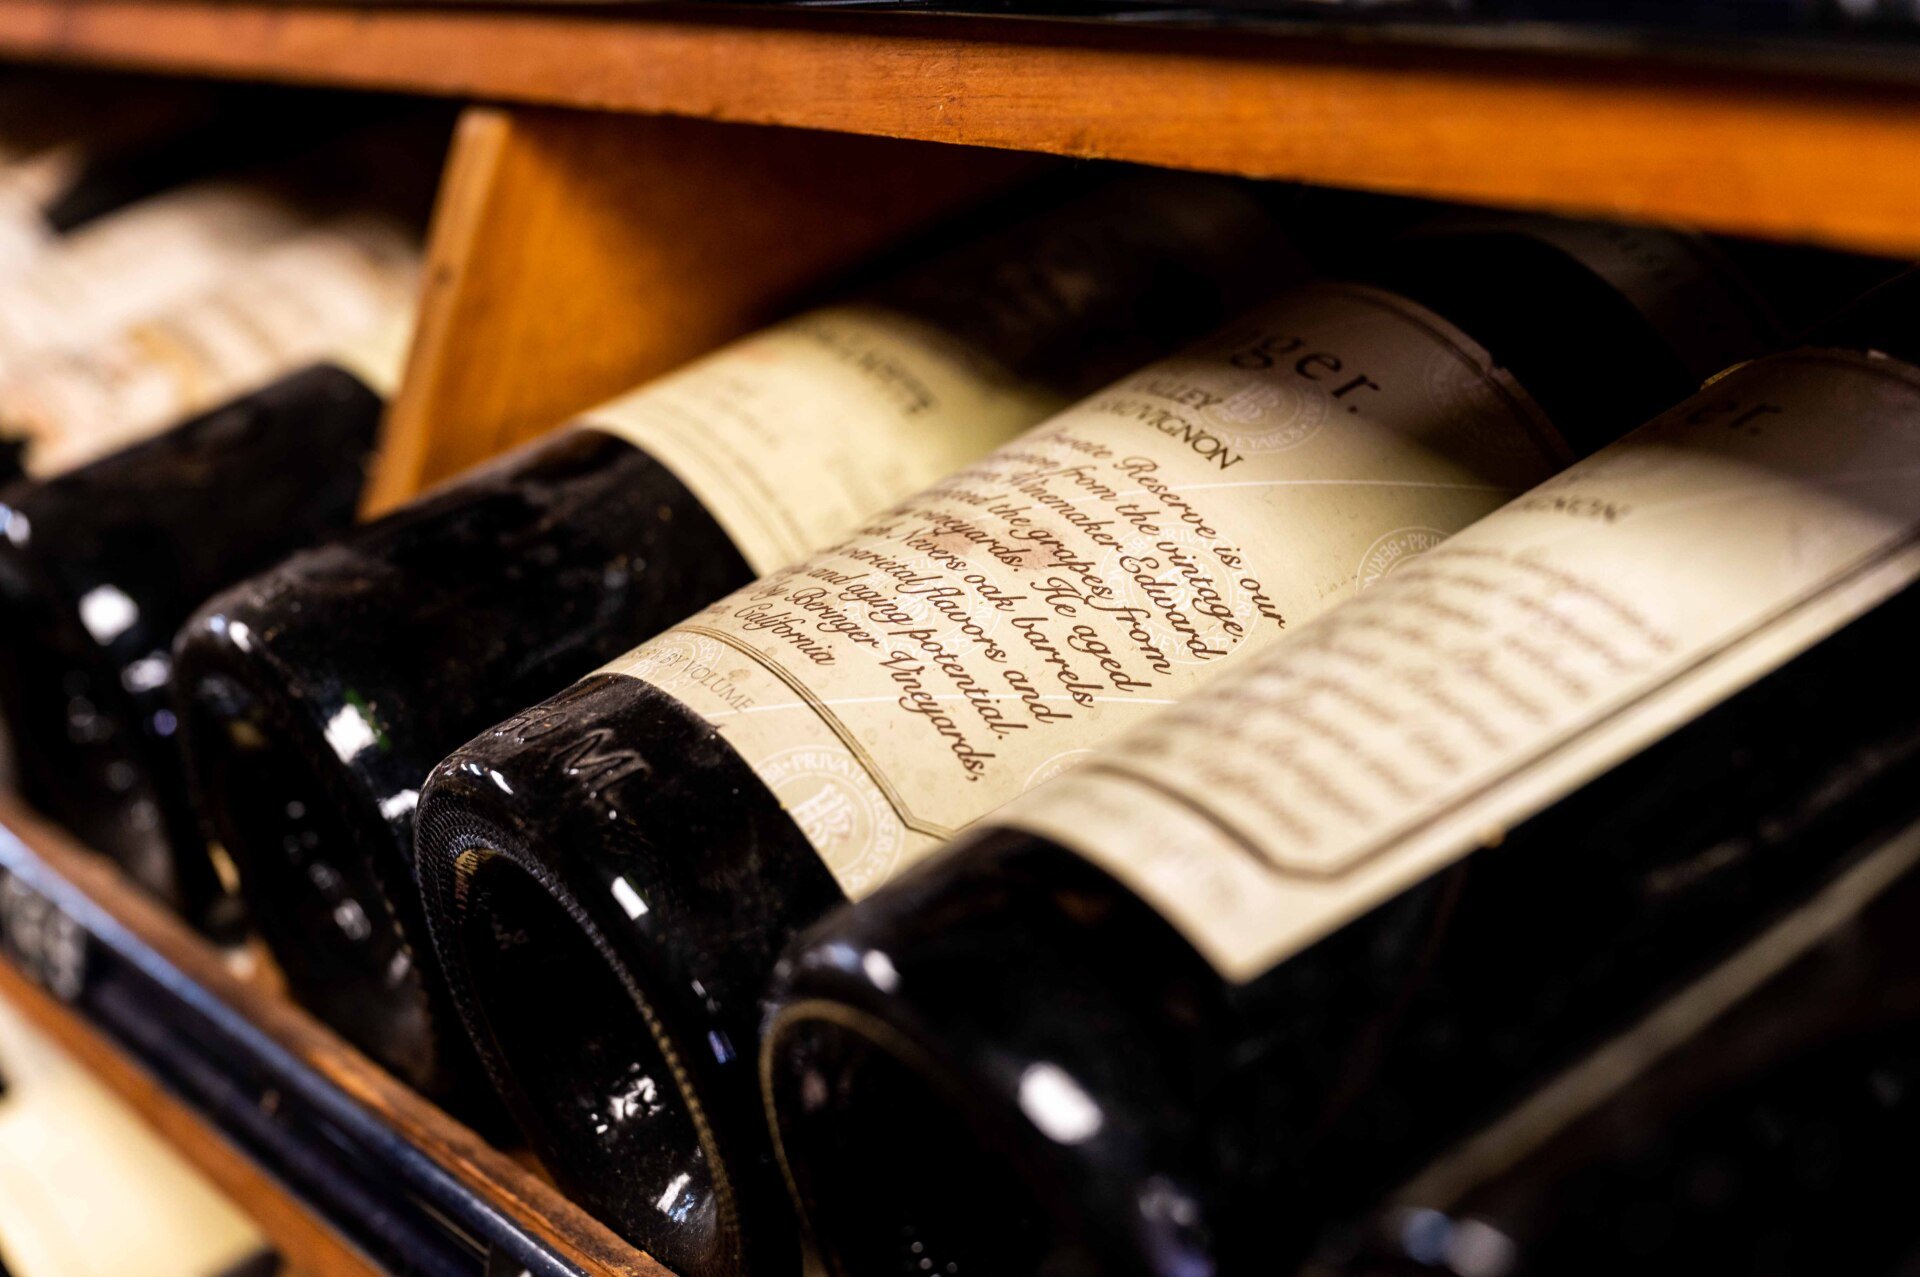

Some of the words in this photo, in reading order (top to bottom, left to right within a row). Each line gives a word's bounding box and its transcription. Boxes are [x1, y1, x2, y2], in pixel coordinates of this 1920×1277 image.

[987, 502, 1032, 528] the
[1006, 469, 1124, 554] Winemaker
[1118, 555, 1229, 660] Edward
[1008, 528, 1114, 600] grapes
[1037, 465, 1119, 502] from
[1115, 496, 1161, 536] the
[1155, 540, 1245, 644] vintage.
[1113, 456, 1217, 540] Reserve
[1213, 547, 1244, 571] is
[1239, 577, 1287, 630] our
[806, 567, 871, 586] and
[838, 583, 915, 627] aging
[886, 527, 967, 572] Nevers
[963, 574, 1028, 612] oak
[1010, 616, 1105, 709] barrels
[911, 509, 1032, 572] vineyards.
[1029, 576, 1087, 618] He
[1066, 624, 1151, 695] aged
[681, 659, 756, 714] VOLUME
[733, 602, 837, 666] California
[783, 586, 881, 649] Beringer
[878, 650, 997, 783] Vineyards,
[838, 547, 944, 587] varietal
[894, 586, 1007, 664] flavors
[1002, 669, 1073, 724] and
[887, 628, 1030, 741] potential.
[1083, 594, 1172, 675] from
